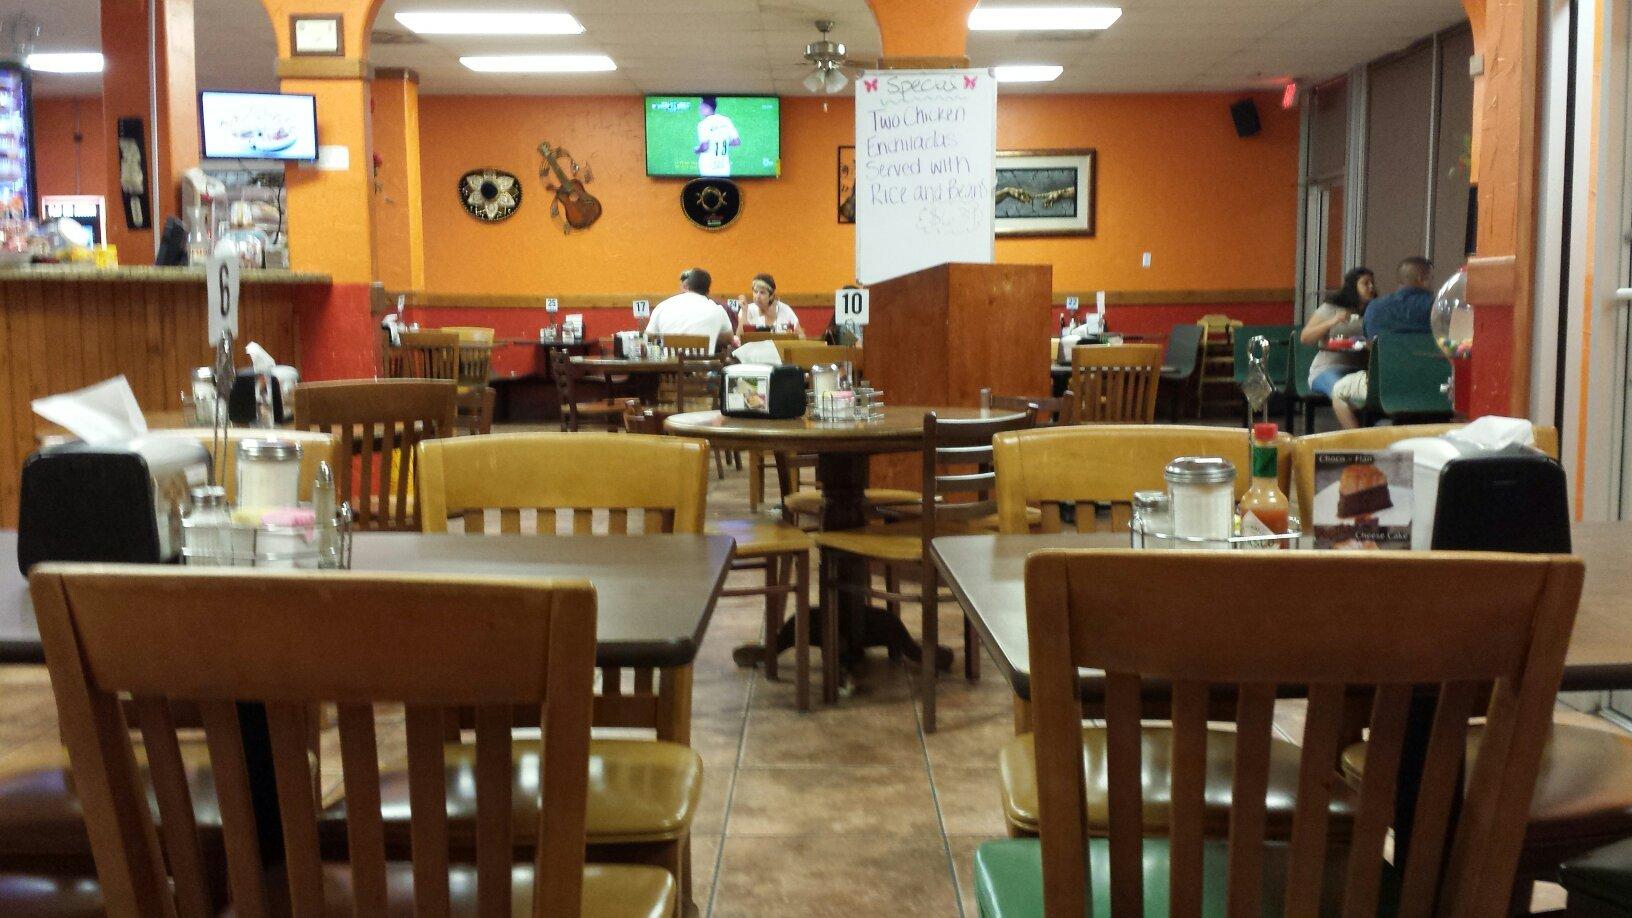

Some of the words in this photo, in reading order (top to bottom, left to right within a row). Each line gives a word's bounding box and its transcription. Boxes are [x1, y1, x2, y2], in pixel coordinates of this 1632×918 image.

[868, 108, 900, 131] Two
[904, 106, 966, 126] Chicken
[866, 130, 958, 157] Enchiladas
[866, 157, 921, 181] Served
[931, 156, 971, 174] with
[871, 182, 908, 206] Rice
[913, 181, 942, 204] and
[219, 263, 230, 317] 6
[635, 301, 646, 312] 17
[842, 292, 863, 314] 10
[1319, 454, 1346, 463] Choco
[1355, 454, 1374, 462] Flan
[1354, 530, 1386, 540] Cheese
[1387, 530, 1409, 540] Cake
